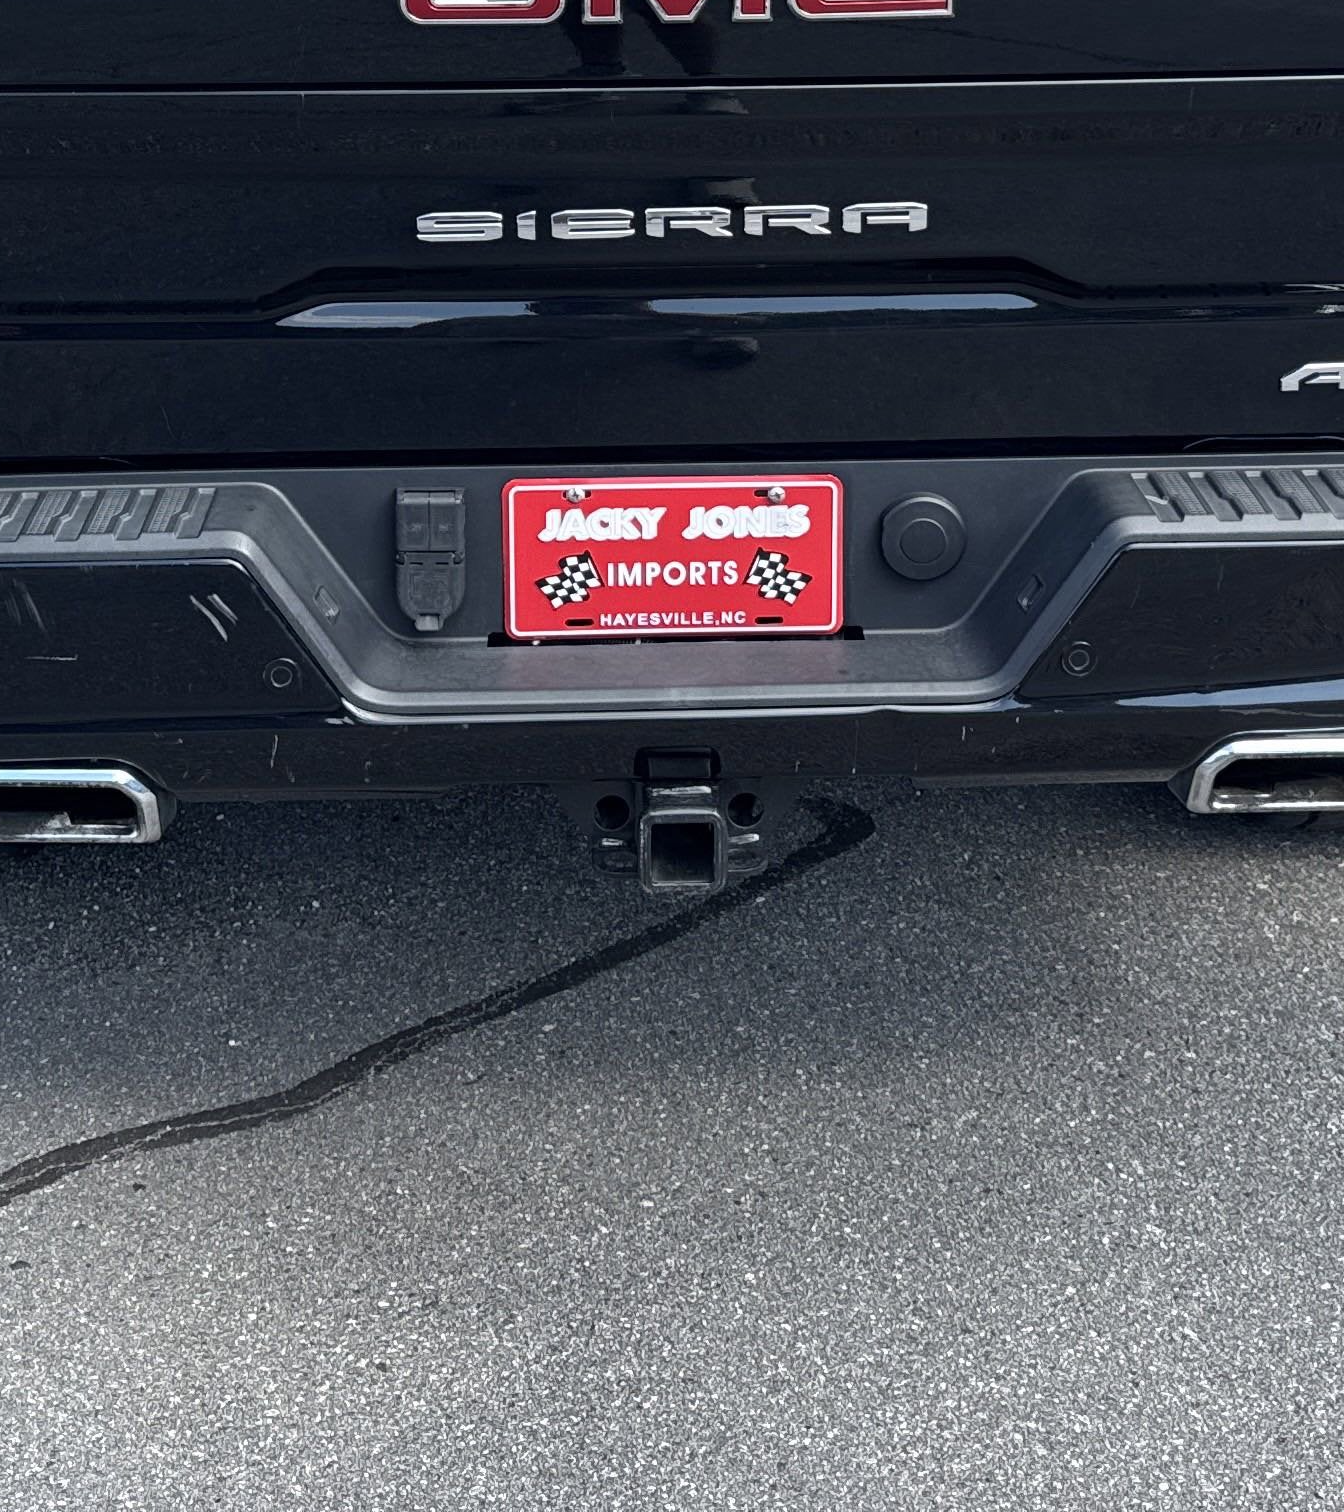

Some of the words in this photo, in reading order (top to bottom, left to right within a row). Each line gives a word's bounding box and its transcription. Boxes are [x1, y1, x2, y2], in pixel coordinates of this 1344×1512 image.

[416, 202, 929, 243] SIERRA
[537, 507, 667, 542] JACKY
[681, 504, 812, 540] JONES
[607, 561, 739, 588] IMPORTS
